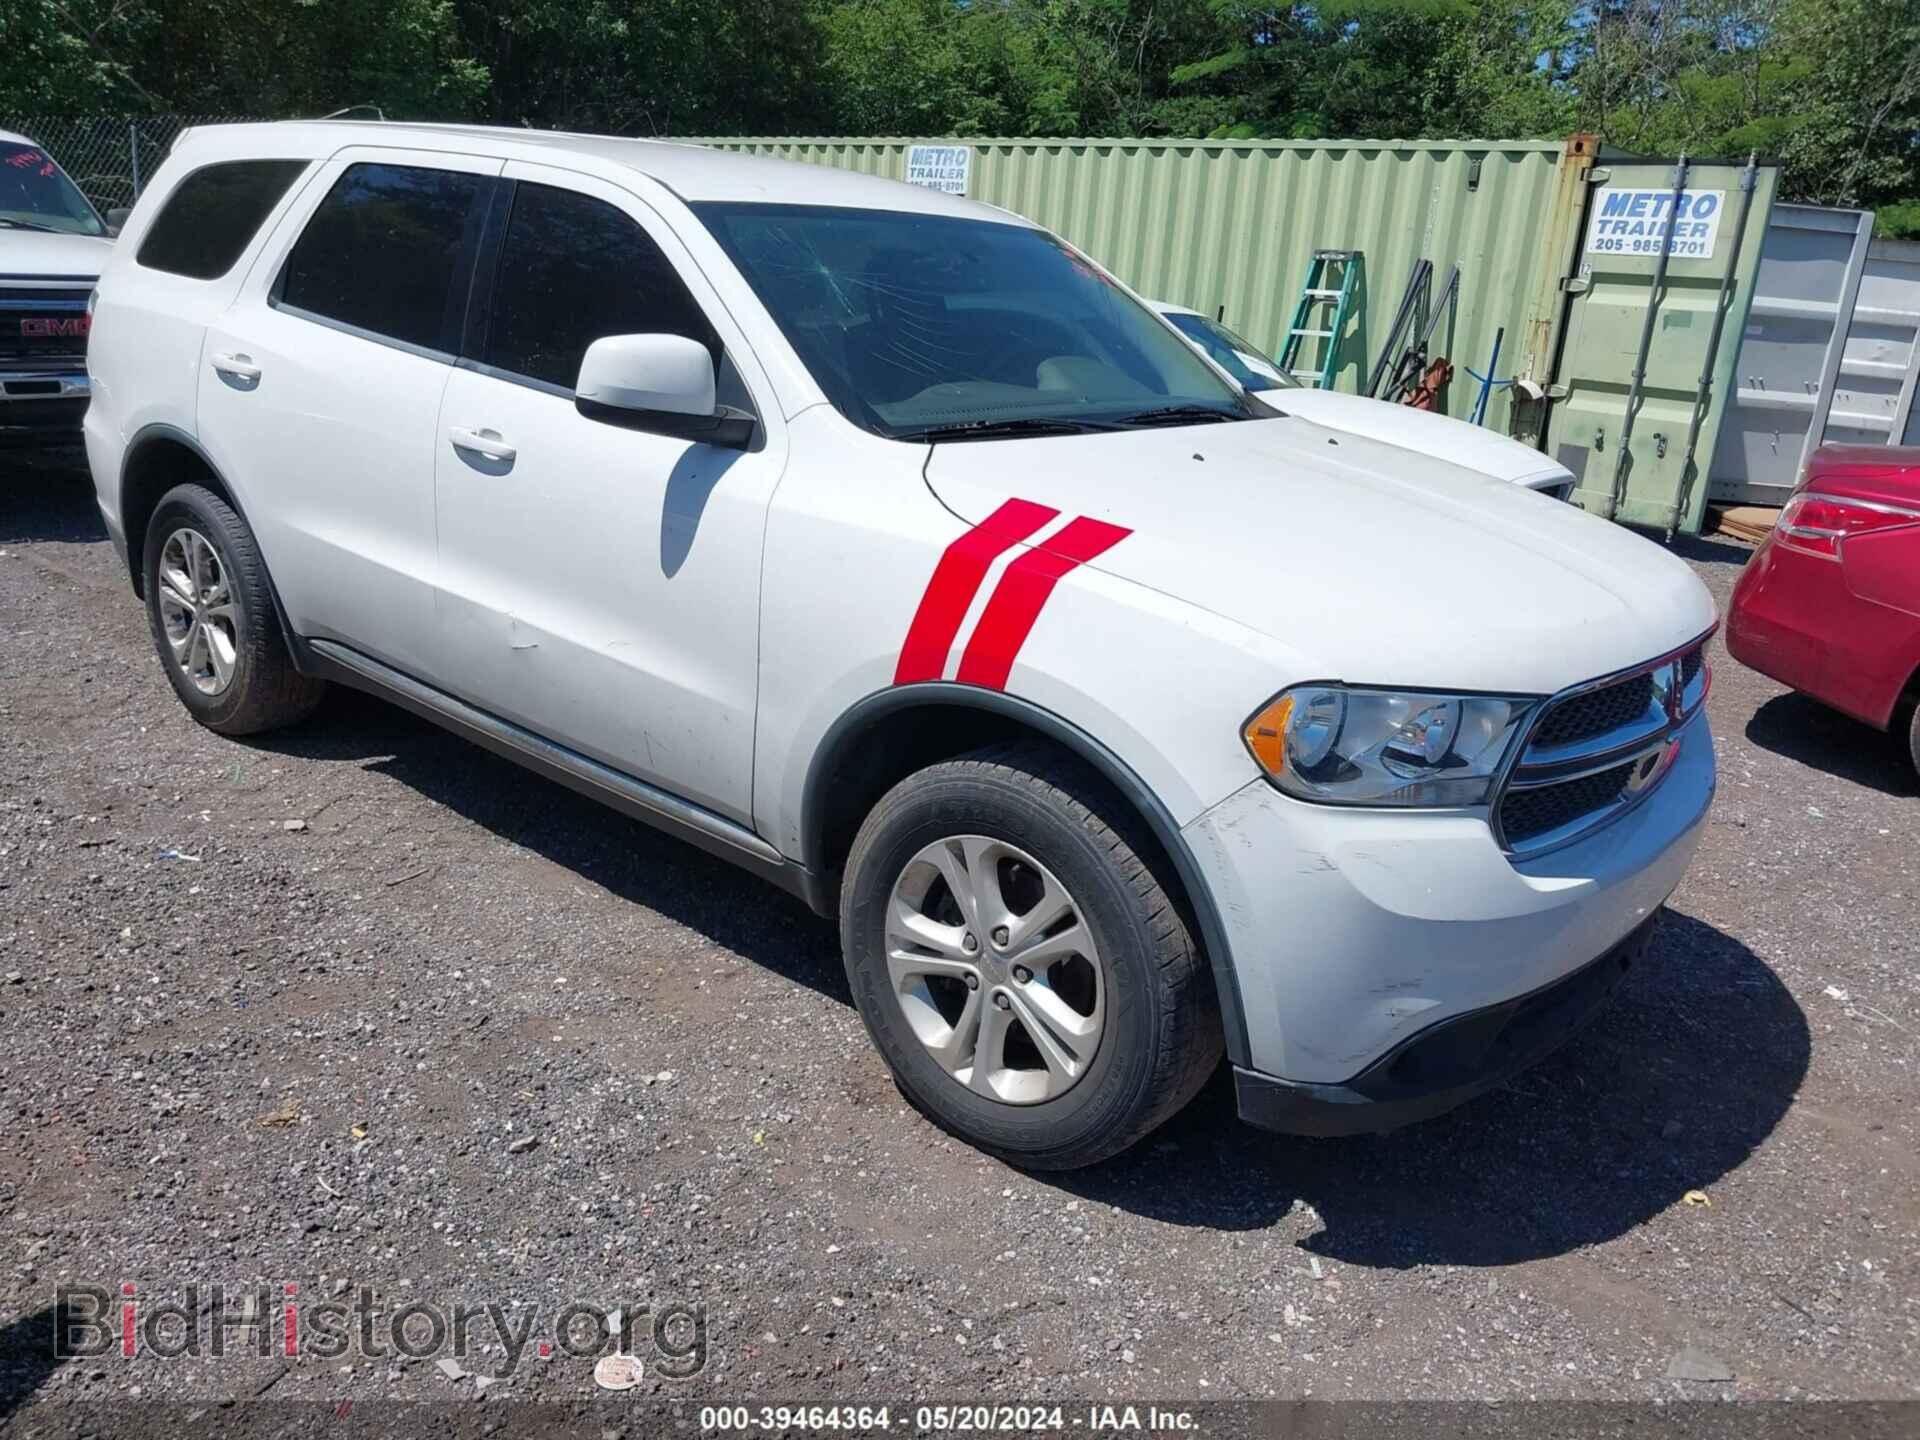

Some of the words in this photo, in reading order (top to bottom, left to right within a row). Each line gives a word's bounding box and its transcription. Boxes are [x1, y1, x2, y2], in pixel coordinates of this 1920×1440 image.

[911, 148, 967, 166] METRO
[910, 167, 965, 179] TRAILER
[1600, 193, 1718, 219] METRO
[1598, 220, 1710, 237] TRAILER
[1595, 238, 1706, 254] 205-9858701
